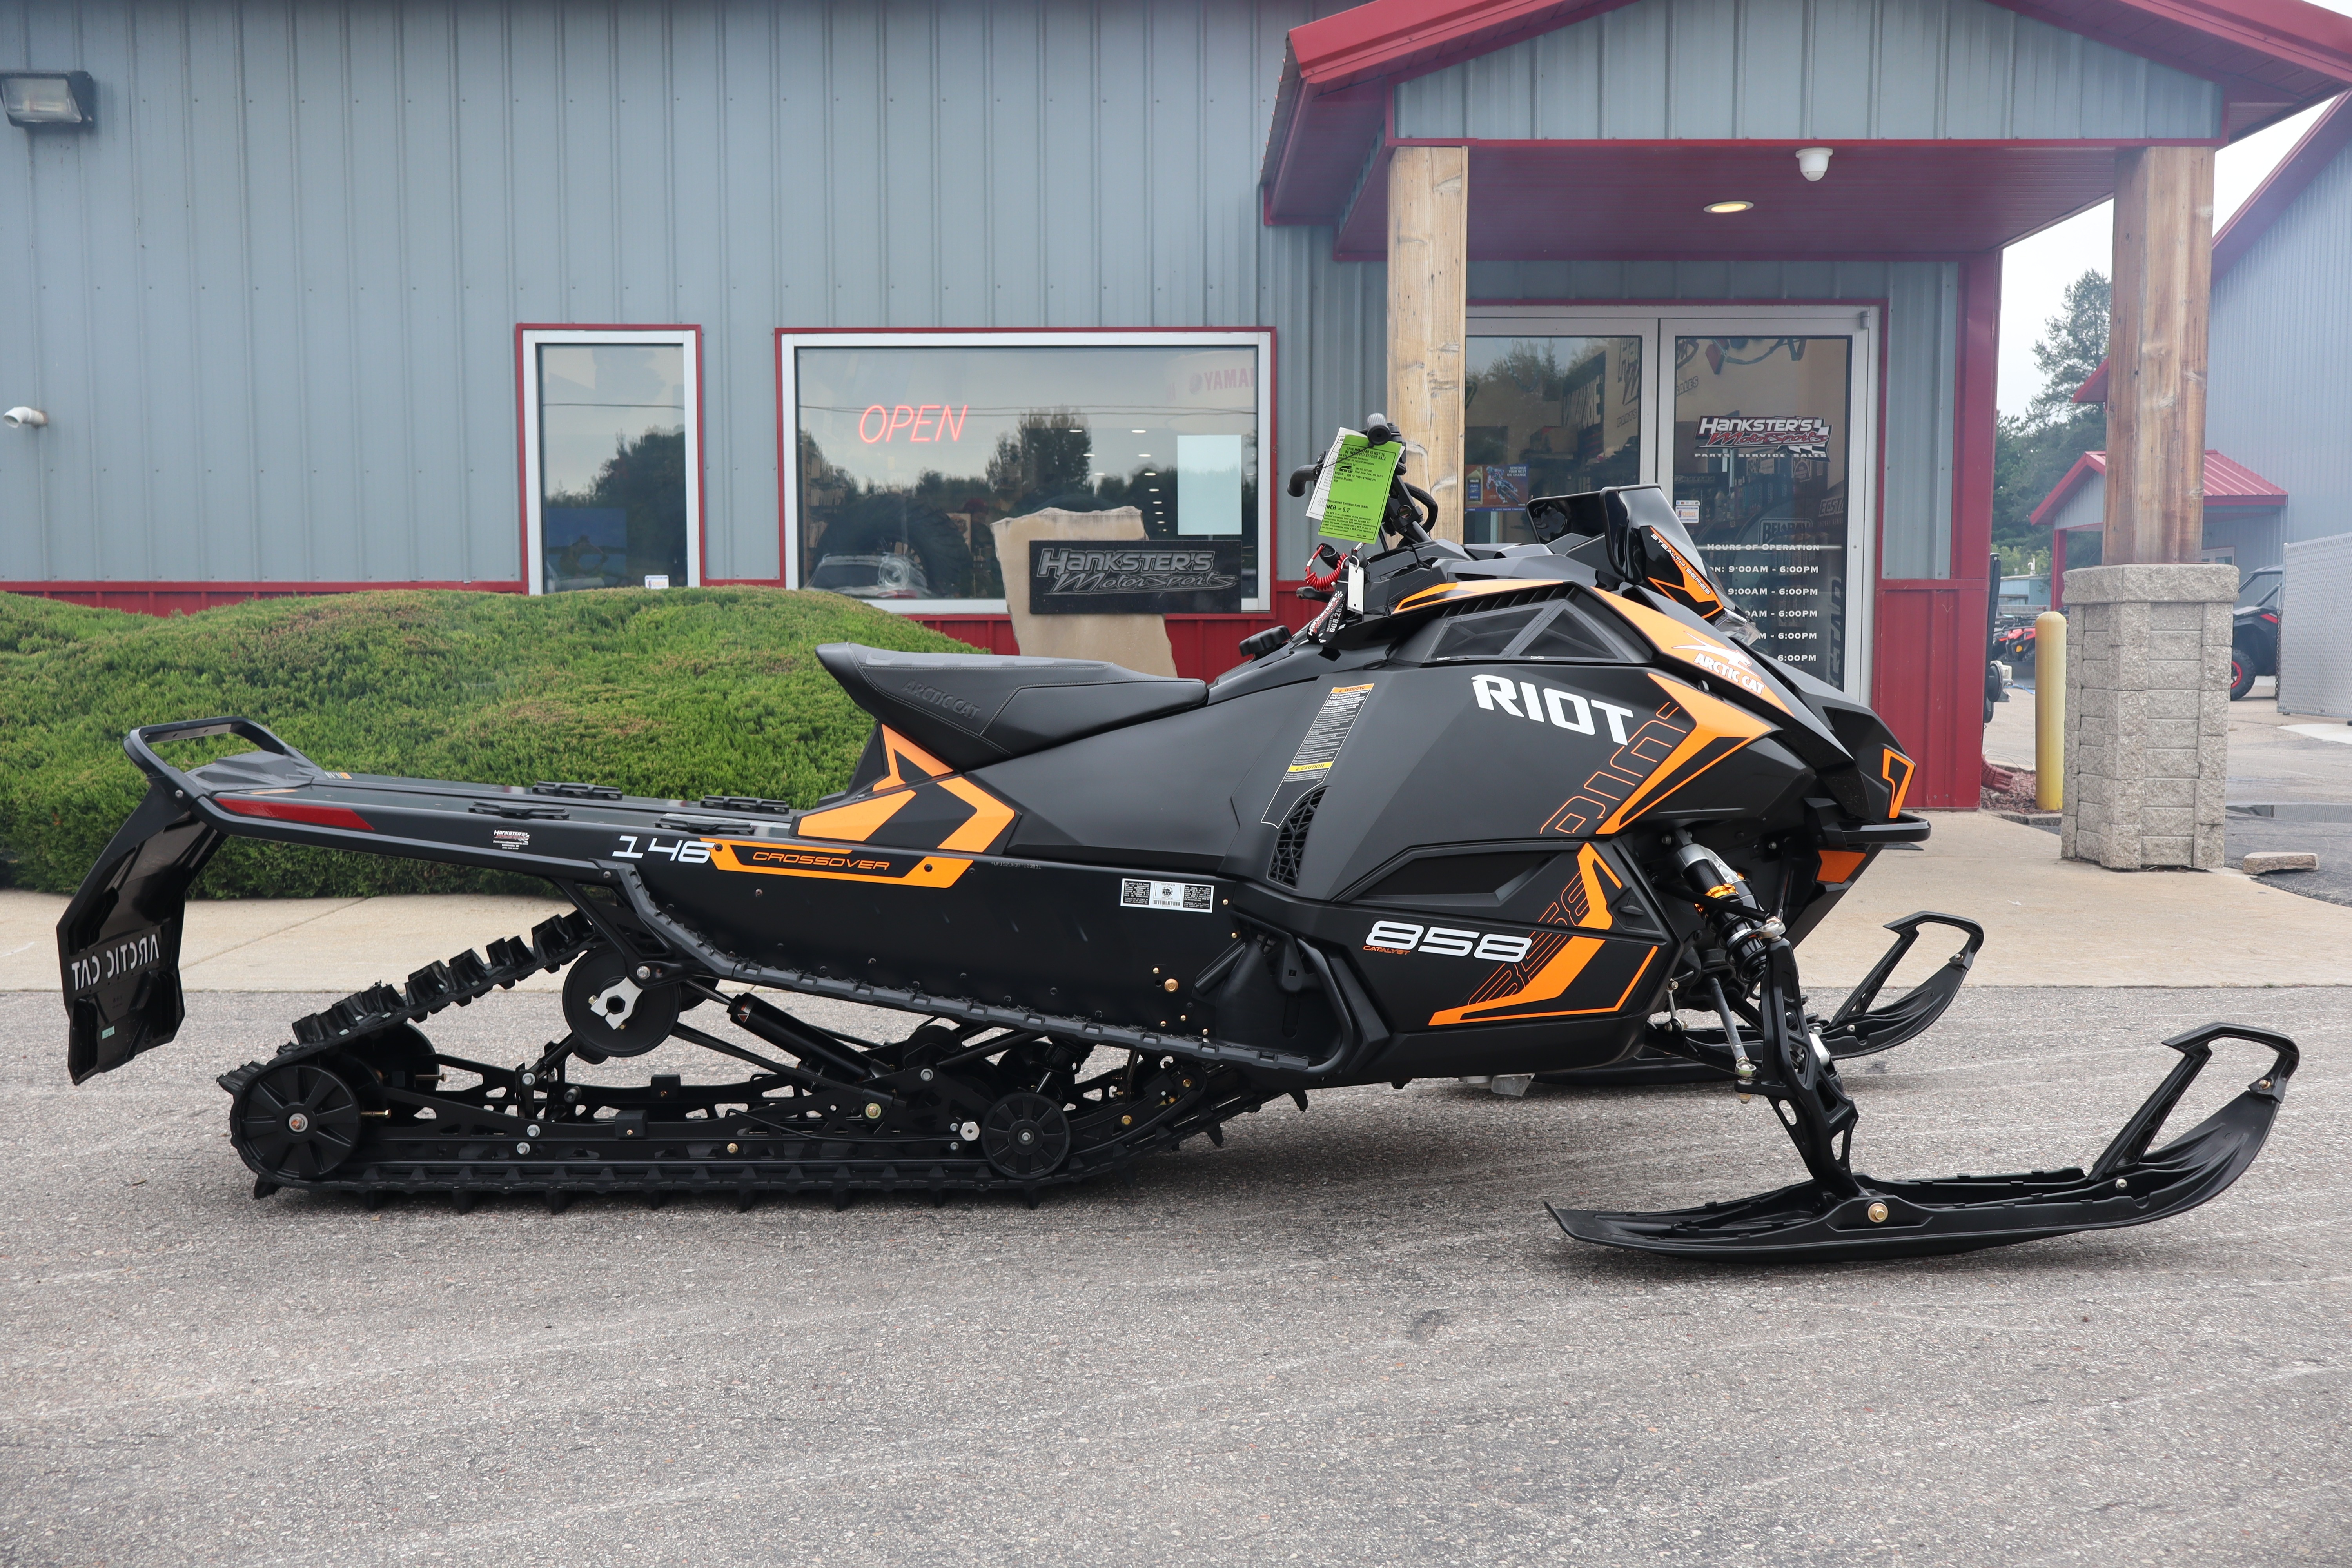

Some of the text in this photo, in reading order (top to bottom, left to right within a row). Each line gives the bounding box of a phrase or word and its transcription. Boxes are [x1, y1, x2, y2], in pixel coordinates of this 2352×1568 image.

[858, 405, 968, 444] OPEN
[1651, 534, 1686, 567] STEALTH
[1686, 568, 1711, 595] SERIES
[1694, 652, 1765, 695] ARCTIC CAT
[901, 679, 981, 719] ARCTIC CAT
[1471, 674, 1634, 746] RIOT
[612, 835, 716, 863] 146
[753, 851, 890, 871] CROSSOVER
[1363, 945, 1411, 956] CATALYST
[1366, 920, 1532, 963] 858
